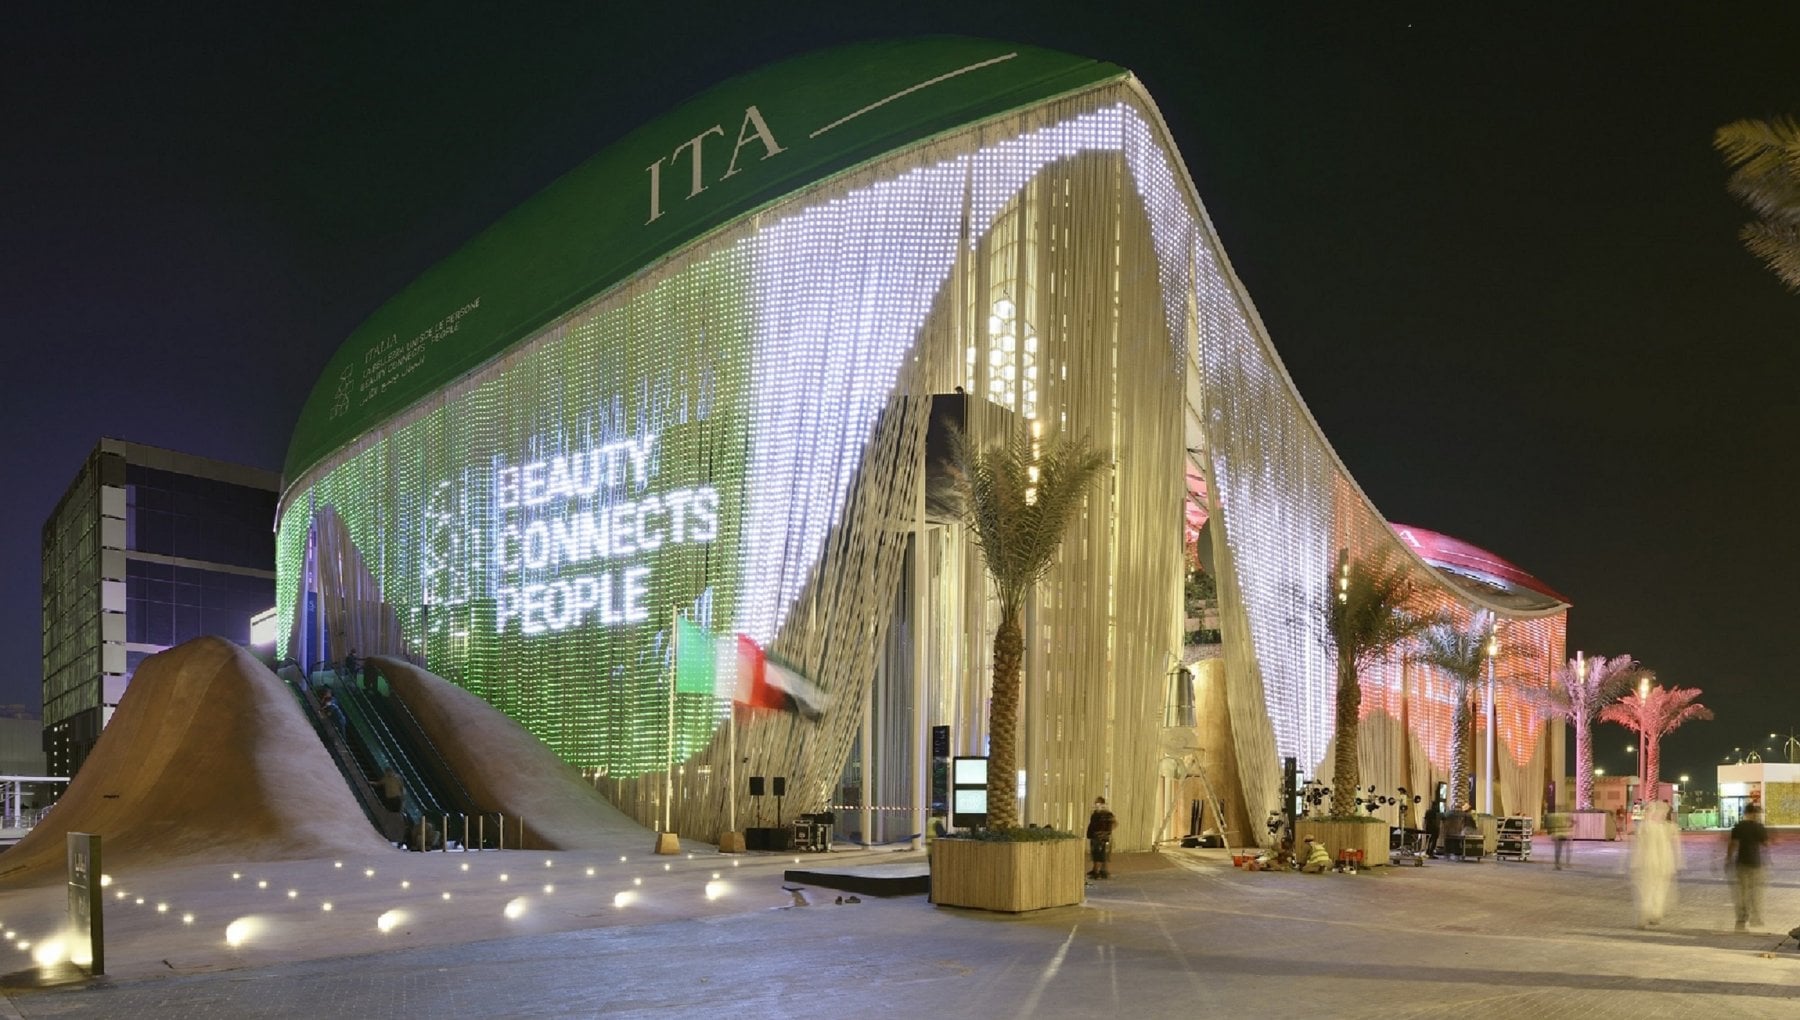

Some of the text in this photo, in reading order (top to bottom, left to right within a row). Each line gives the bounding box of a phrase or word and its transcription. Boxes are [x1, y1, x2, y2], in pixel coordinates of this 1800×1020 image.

[644, 105, 789, 226] ITA
[445, 297, 481, 325] PERSONE
[499, 433, 657, 510] BEAUTY
[498, 486, 720, 571] CONNECTS
[496, 565, 650, 635] PEOPLE
